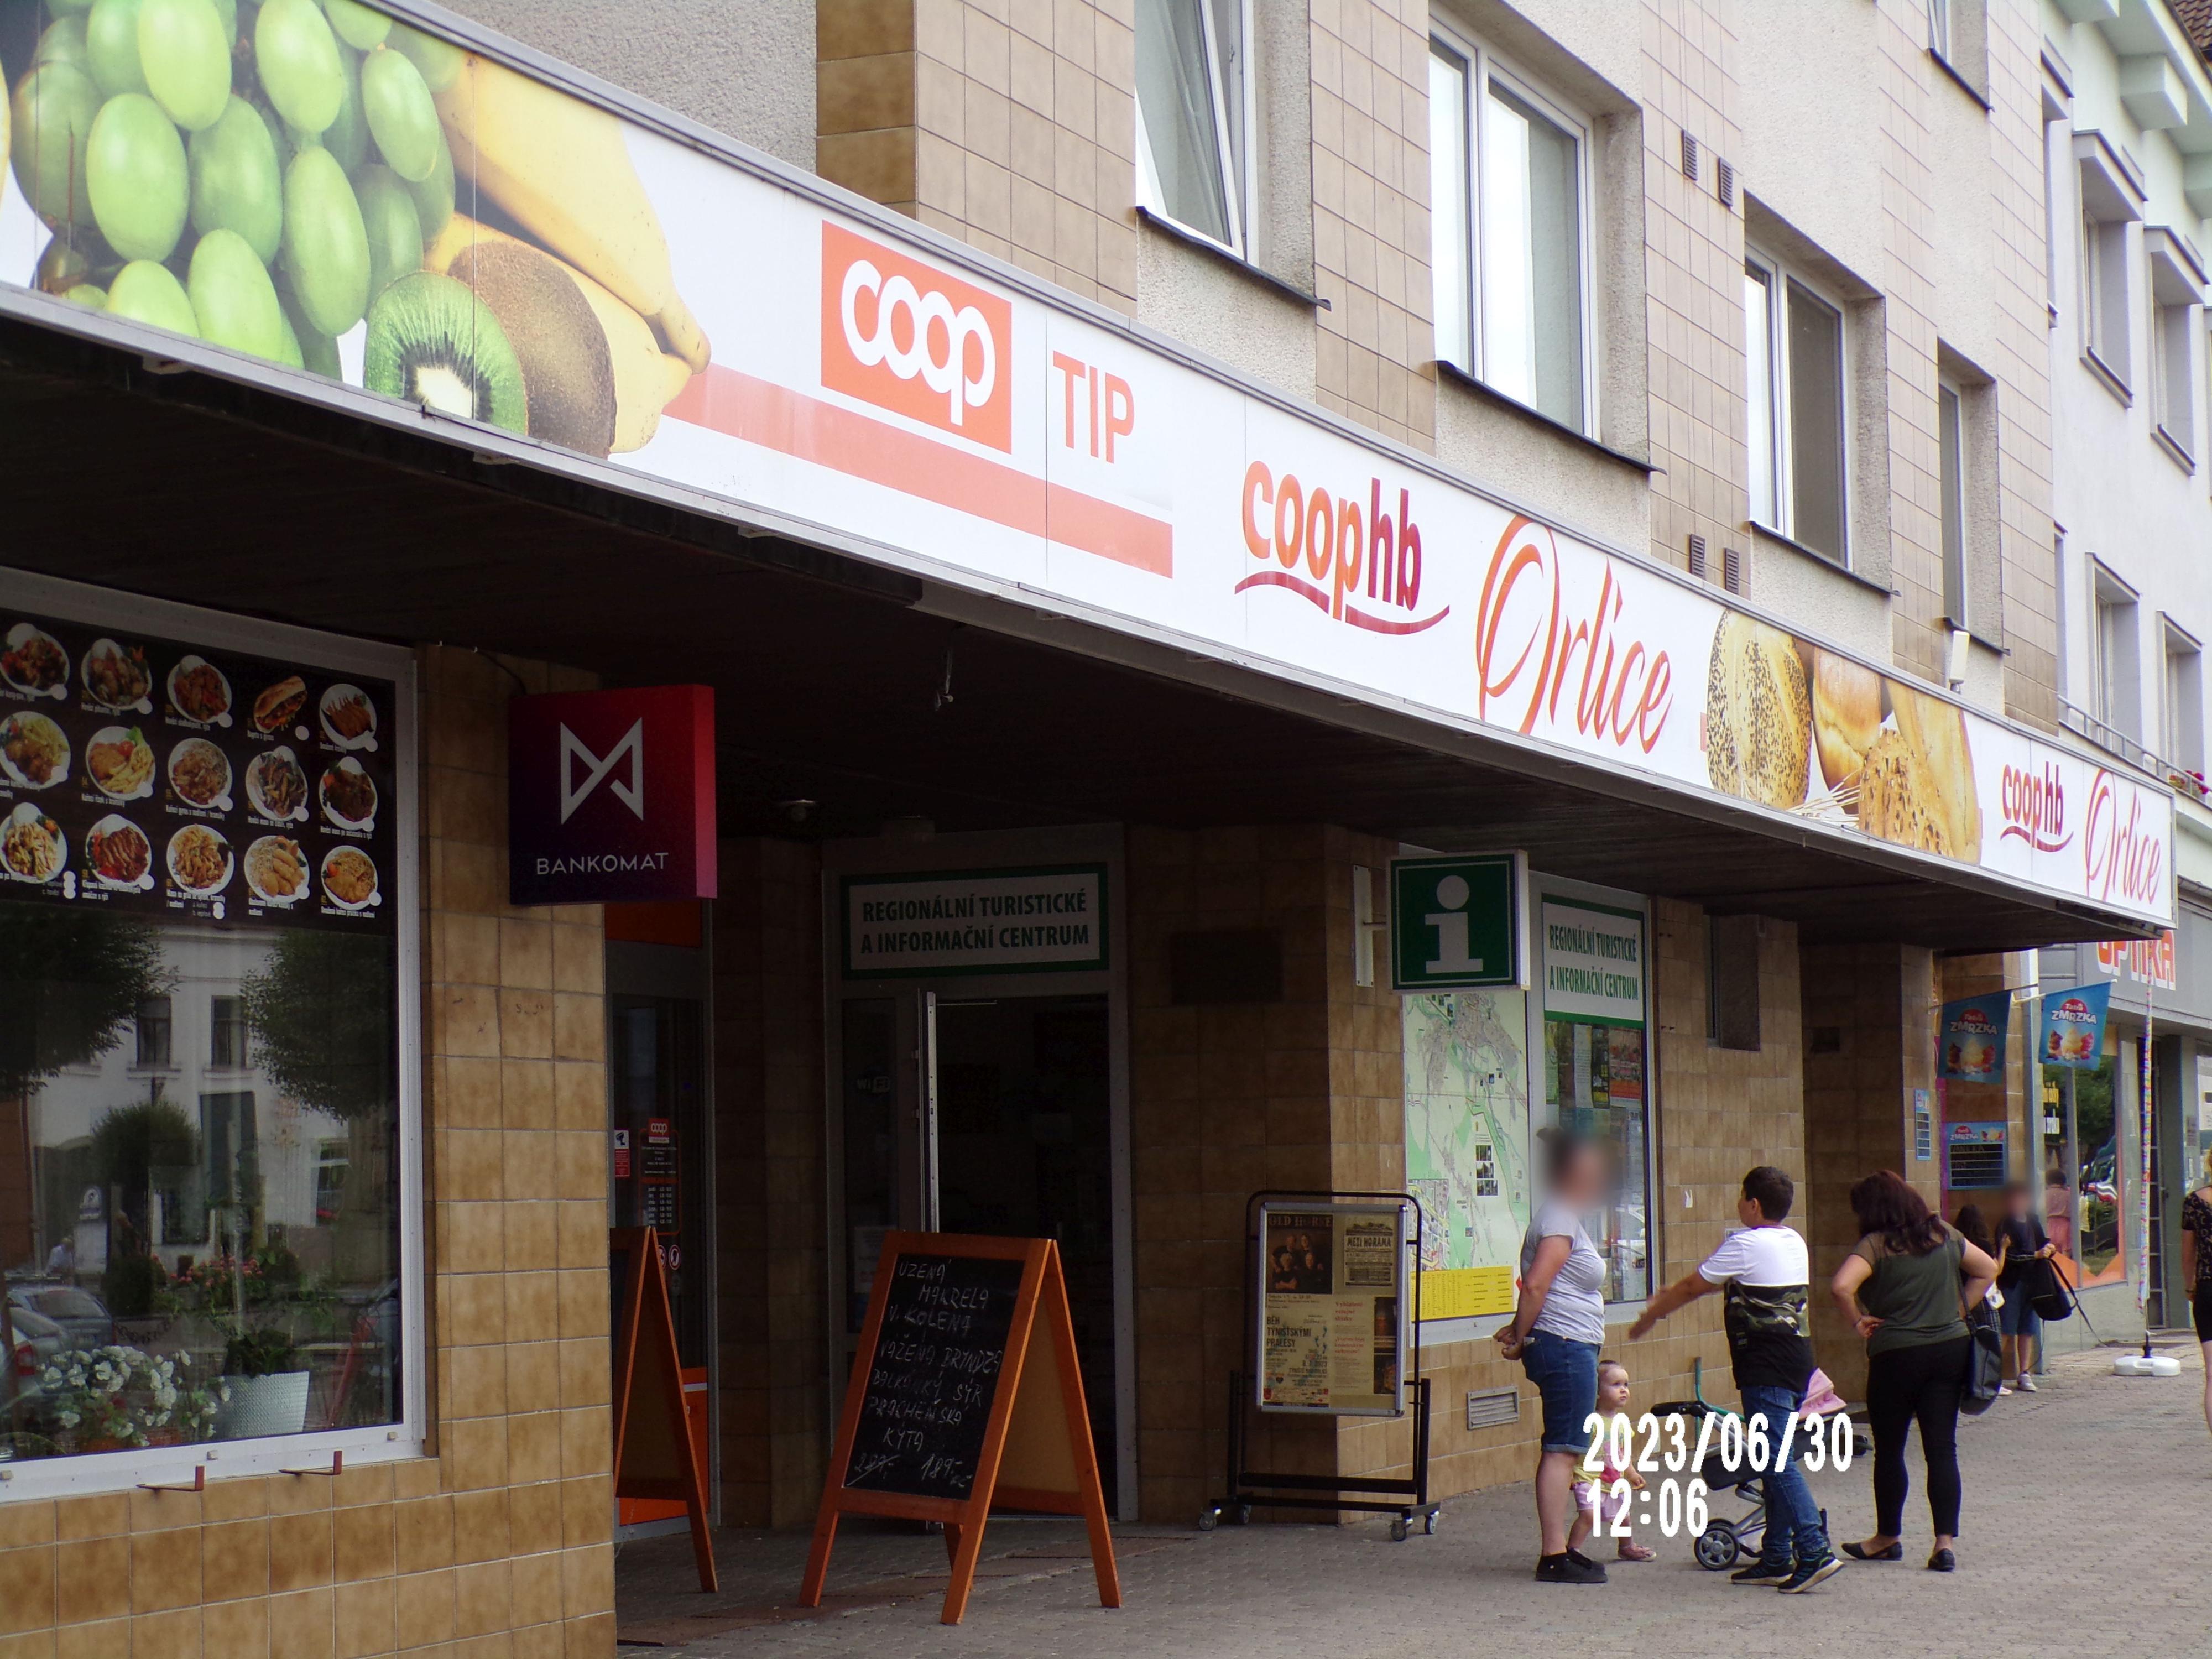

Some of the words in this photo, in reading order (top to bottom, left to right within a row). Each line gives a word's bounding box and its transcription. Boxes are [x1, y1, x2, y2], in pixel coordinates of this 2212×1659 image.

[841, 260, 995, 426] coop
[1053, 350, 1135, 464] TIP
[1476, 514, 1674, 754] Orlice
[2085, 768, 2162, 905] Orlice
[536, 852, 669, 875] BANKOMAT
[863, 894, 974, 922] REGIONÁLNÍ
[979, 888, 1087, 916] TURISTICKÉ
[861, 934, 873, 954] A
[878, 925, 994, 953] INFORMAČNÍ
[999, 924, 1089, 948] CENTRUM
[1549, 925, 1595, 953] REGIONÁLNÍ
[1595, 932, 1637, 962] TURISTICKÉ
[1550, 965, 1555, 991] A
[1556, 966, 1604, 995] INFORMAČNÍ
[1604, 973, 1639, 1001] CENTRUM
[1949, 1021, 1998, 1035] ZMRZKA
[2051, 1010, 2097, 1024] ZMRZKA
[918, 1284, 989, 1310] MAKRELA
[953, 1378, 983, 1407] SÝR
